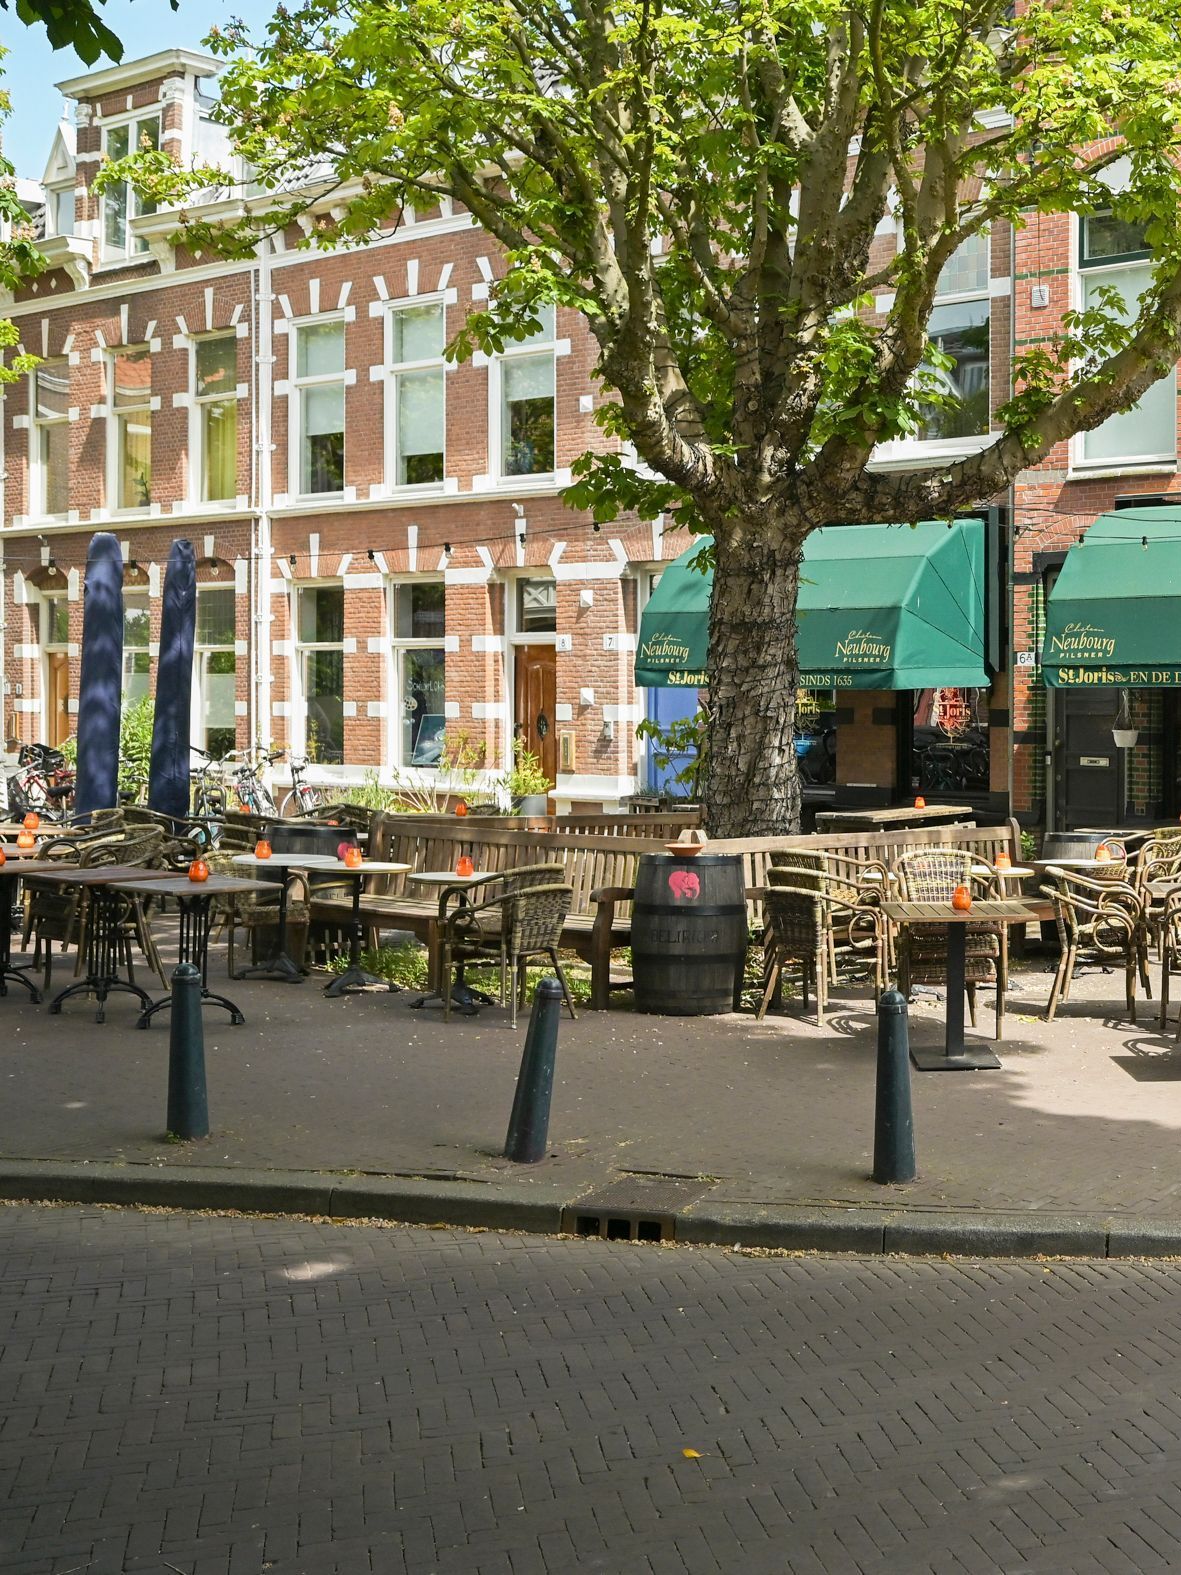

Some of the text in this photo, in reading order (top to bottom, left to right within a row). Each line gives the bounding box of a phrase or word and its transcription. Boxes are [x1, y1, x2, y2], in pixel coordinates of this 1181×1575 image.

[608, 637, 613, 648] 7
[1049, 631, 1117, 657] Neubourg
[640, 640, 690, 663] Neubourg
[834, 637, 891, 663] Neubourg
[800, 674, 831, 686] SINDS
[833, 675, 852, 686] 1635
[1130, 671, 1148, 683] EN
[1152, 671, 1171, 683] DE
[946, 704, 971, 718] Joris
